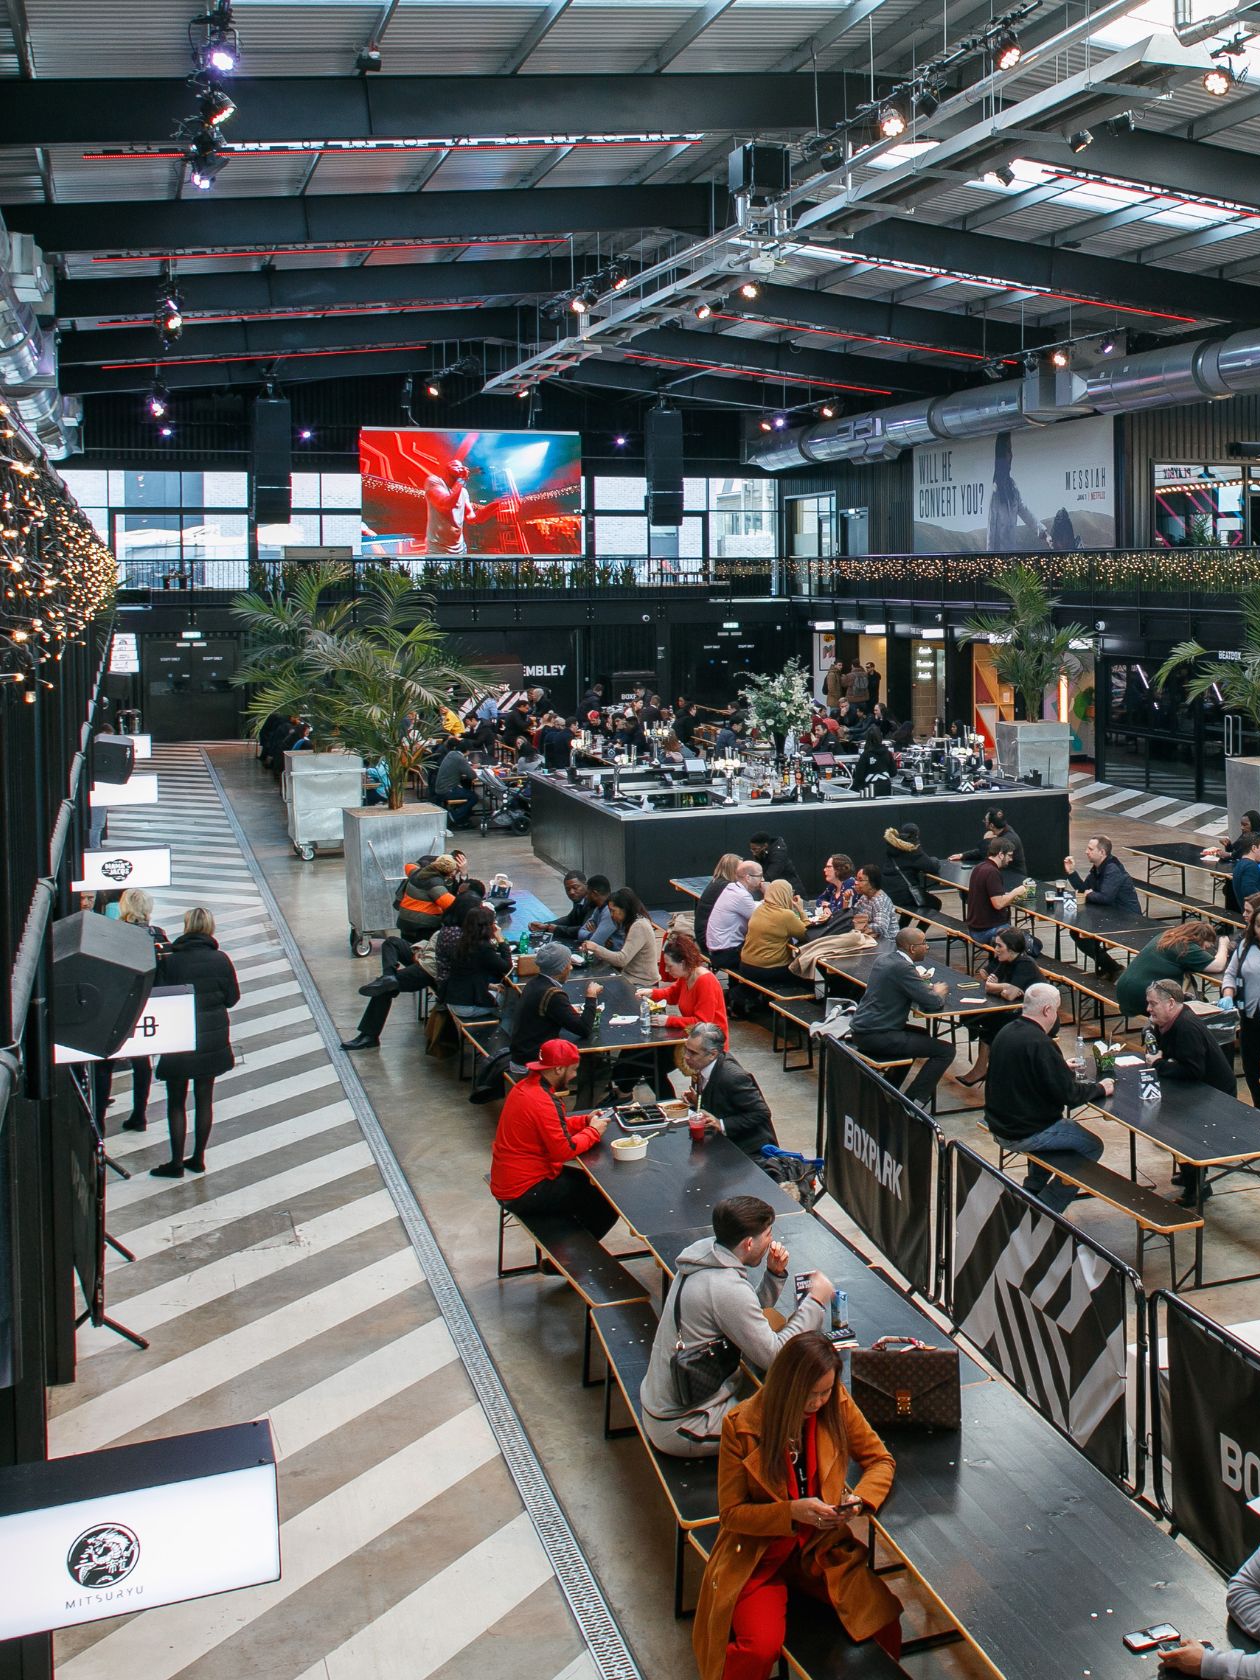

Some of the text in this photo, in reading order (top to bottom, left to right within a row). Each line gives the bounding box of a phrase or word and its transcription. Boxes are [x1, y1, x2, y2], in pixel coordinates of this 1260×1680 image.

[918, 451, 953, 485] WILL HE
[1065, 467, 1105, 490] MESSIAH
[919, 483, 984, 519] CONVERT YOU?
[844, 1114, 903, 1201] BOXPARK
[65, 1586, 144, 1609] MITSURYU
